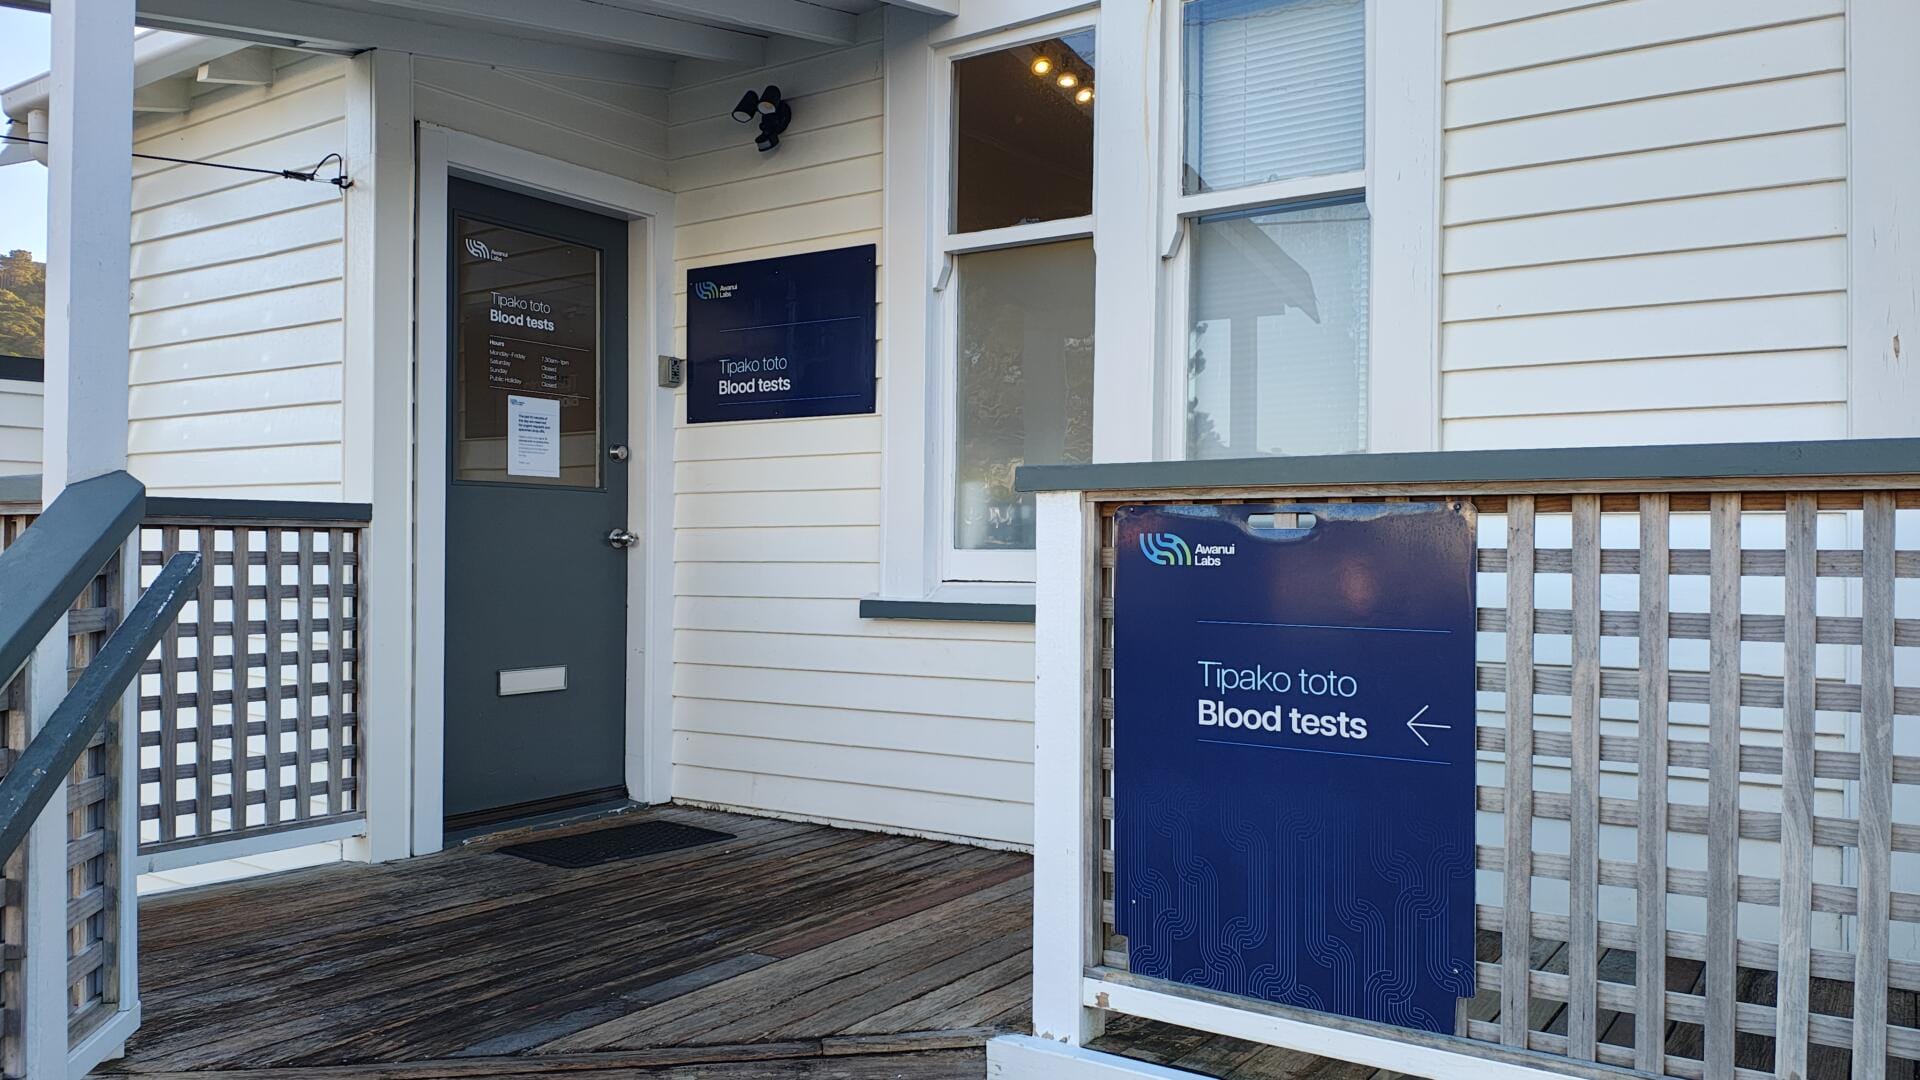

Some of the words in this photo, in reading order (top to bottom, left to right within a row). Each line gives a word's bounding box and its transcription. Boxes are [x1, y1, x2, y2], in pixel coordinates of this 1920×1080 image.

[720, 284, 737, 292] Awanui
[490, 291, 528, 310] Tipako
[529, 300, 551, 314] toto
[490, 309, 524, 326] Blood
[526, 316, 555, 331] tests
[489, 339, 505, 347] Hours
[489, 358, 511, 367] Saturday
[719, 357, 760, 377] Tipako
[762, 356, 788, 371] toto
[489, 367, 508, 375] Sunday
[541, 373, 557, 381] Closed
[489, 375, 504, 383] Public
[505, 376, 522, 385] Holiday
[541, 381, 557, 389] Closed
[719, 378, 755, 395] Blood
[758, 377, 791, 392] tests
[1195, 543, 1235, 555] Awanui
[1194, 555, 1221, 566] Labs
[1197, 660, 1292, 695] Tipako
[1298, 668, 1358, 698] toto
[1198, 699, 1282, 732] Blood
[1288, 708, 1368, 740] tests
